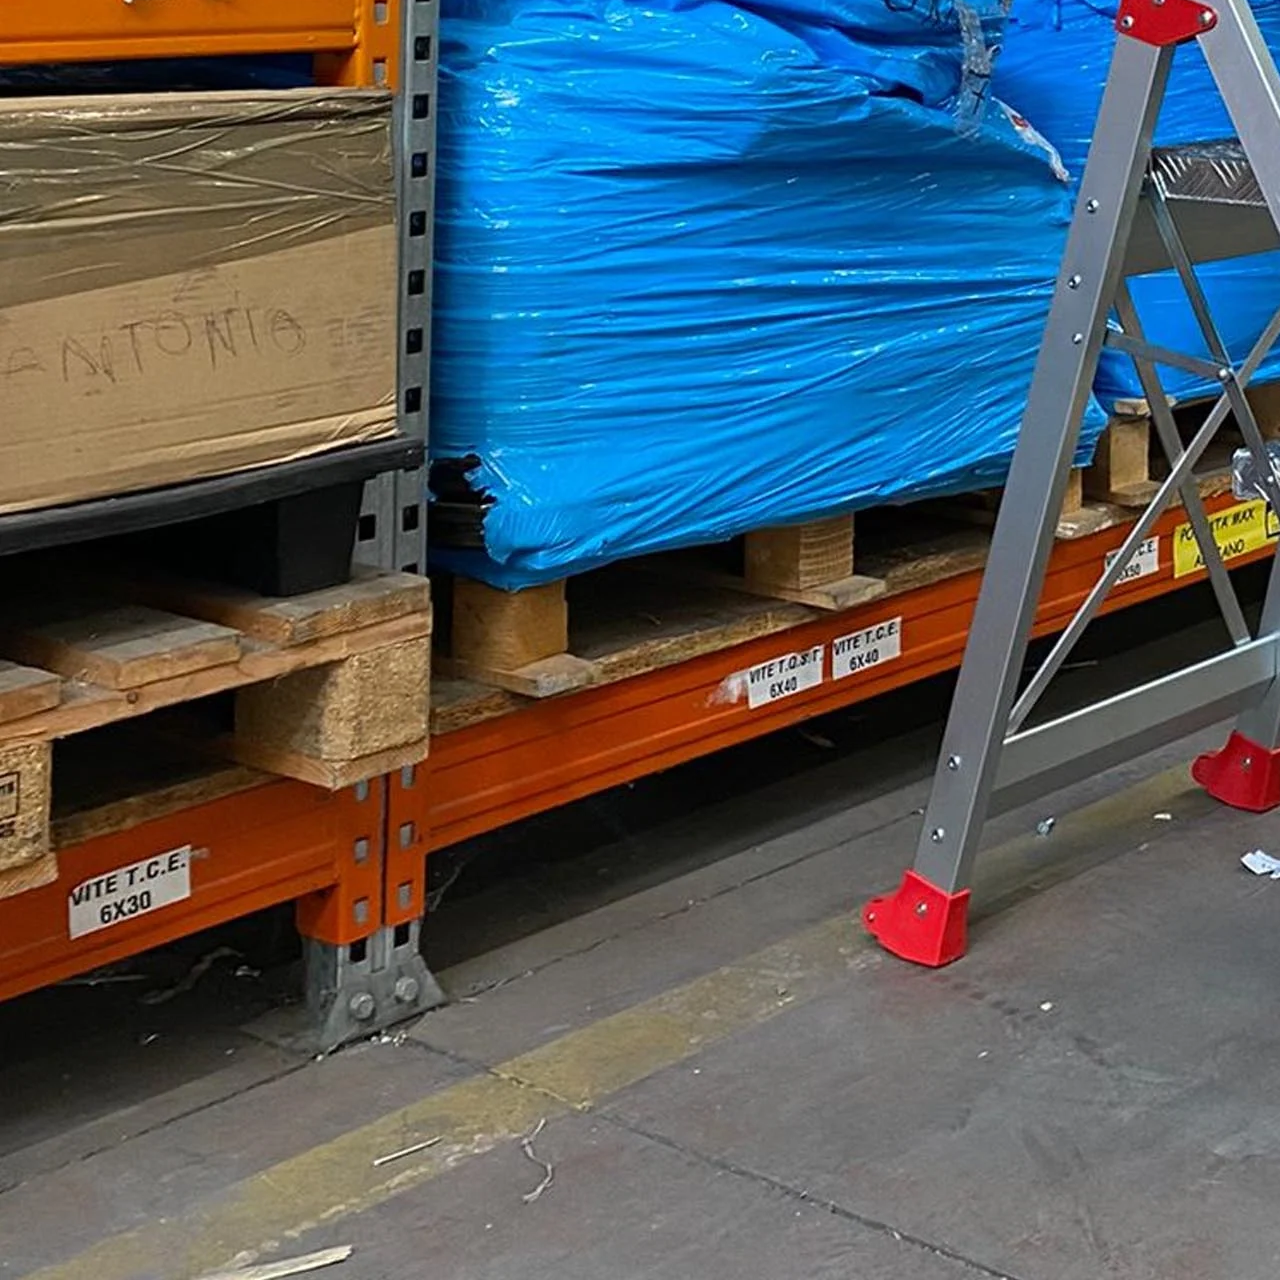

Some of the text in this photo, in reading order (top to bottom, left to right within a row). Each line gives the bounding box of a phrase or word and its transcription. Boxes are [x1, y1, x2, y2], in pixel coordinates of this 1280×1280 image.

[1231, 507, 1256, 524] MAX
[834, 622, 898, 656] VITE T.C.E.
[849, 649, 879, 671] 6X40
[750, 664, 777, 684] VITE
[769, 677, 798, 699] 6X40
[72, 852, 187, 907] VITE T.C.E.
[100, 890, 151, 924] 6X30
